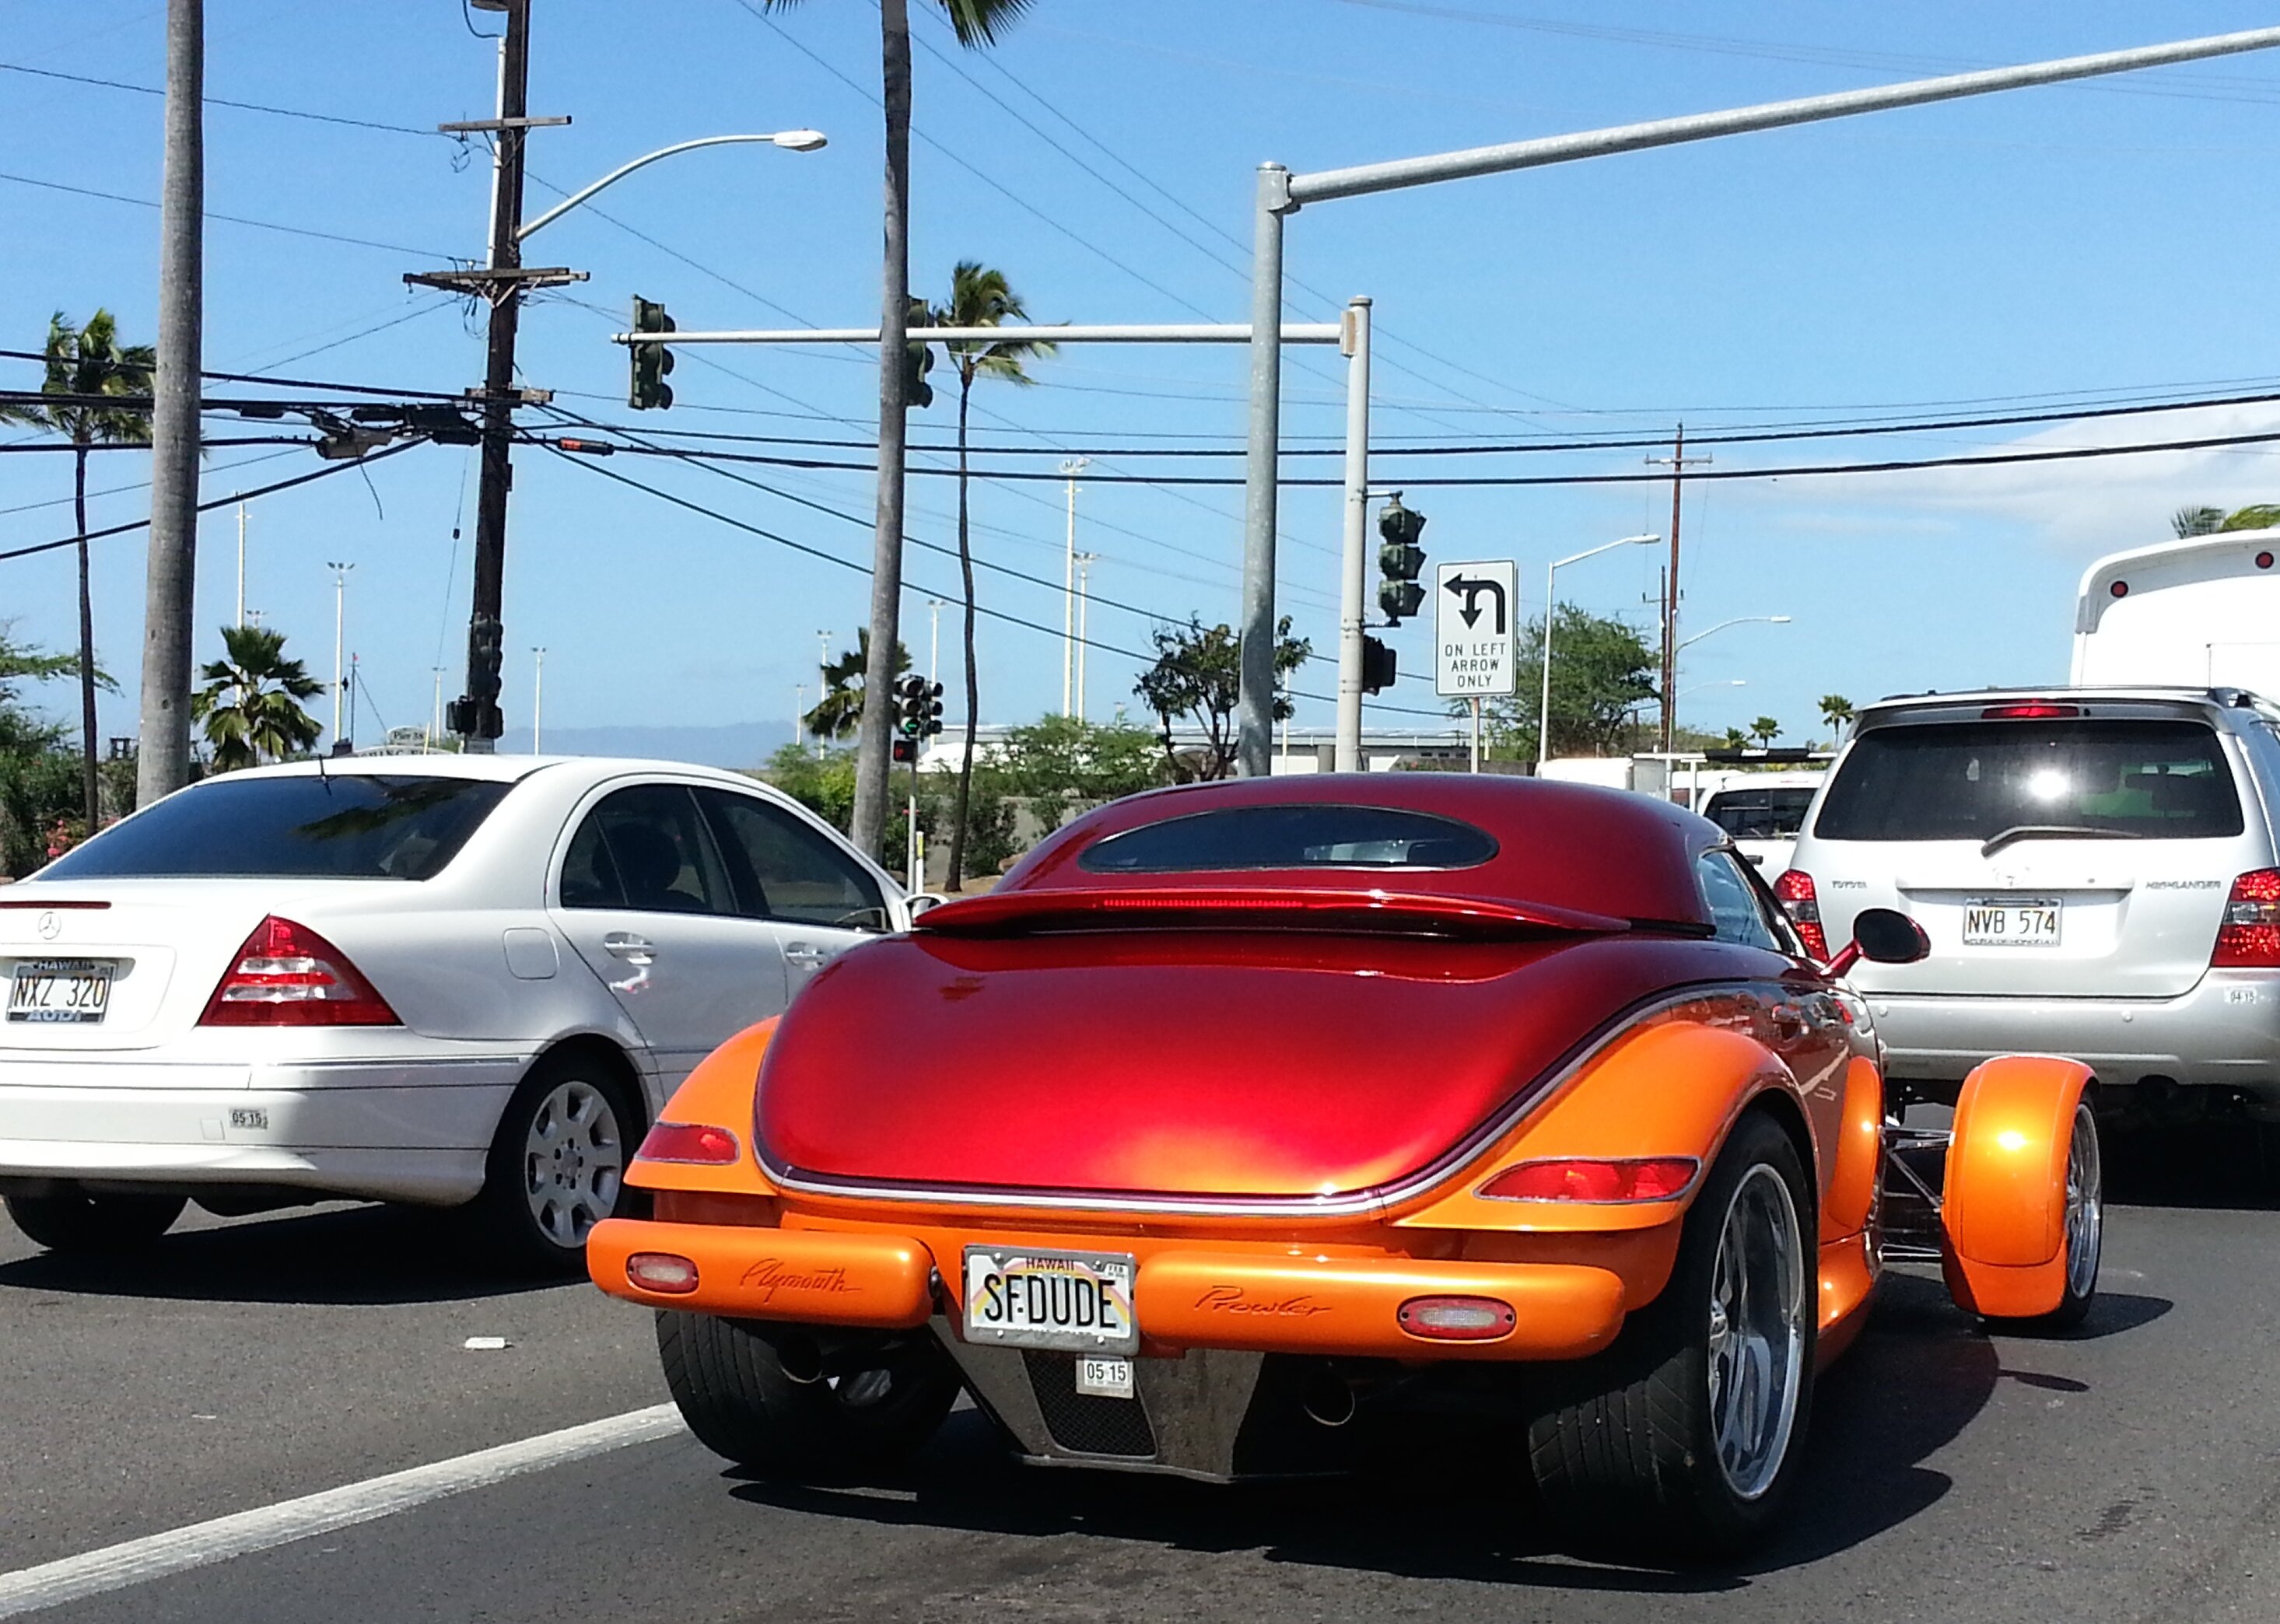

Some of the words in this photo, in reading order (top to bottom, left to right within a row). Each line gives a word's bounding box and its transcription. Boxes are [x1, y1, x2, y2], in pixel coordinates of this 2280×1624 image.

[1445, 643, 1463, 657] ON
[1473, 642, 1506, 656] LEFT
[1451, 659, 1500, 672] ARROW
[1457, 674, 1493, 688] ONLY
[1968, 909, 2005, 934] NVB
[2019, 909, 2056, 935] 574
[13, 975, 57, 1007] NXZ
[66, 976, 107, 1007] 320
[1026, 1257, 1074, 1271] HAWAII
[740, 1258, 862, 1303] Plymouth
[1194, 1285, 1333, 1316] Prowler
